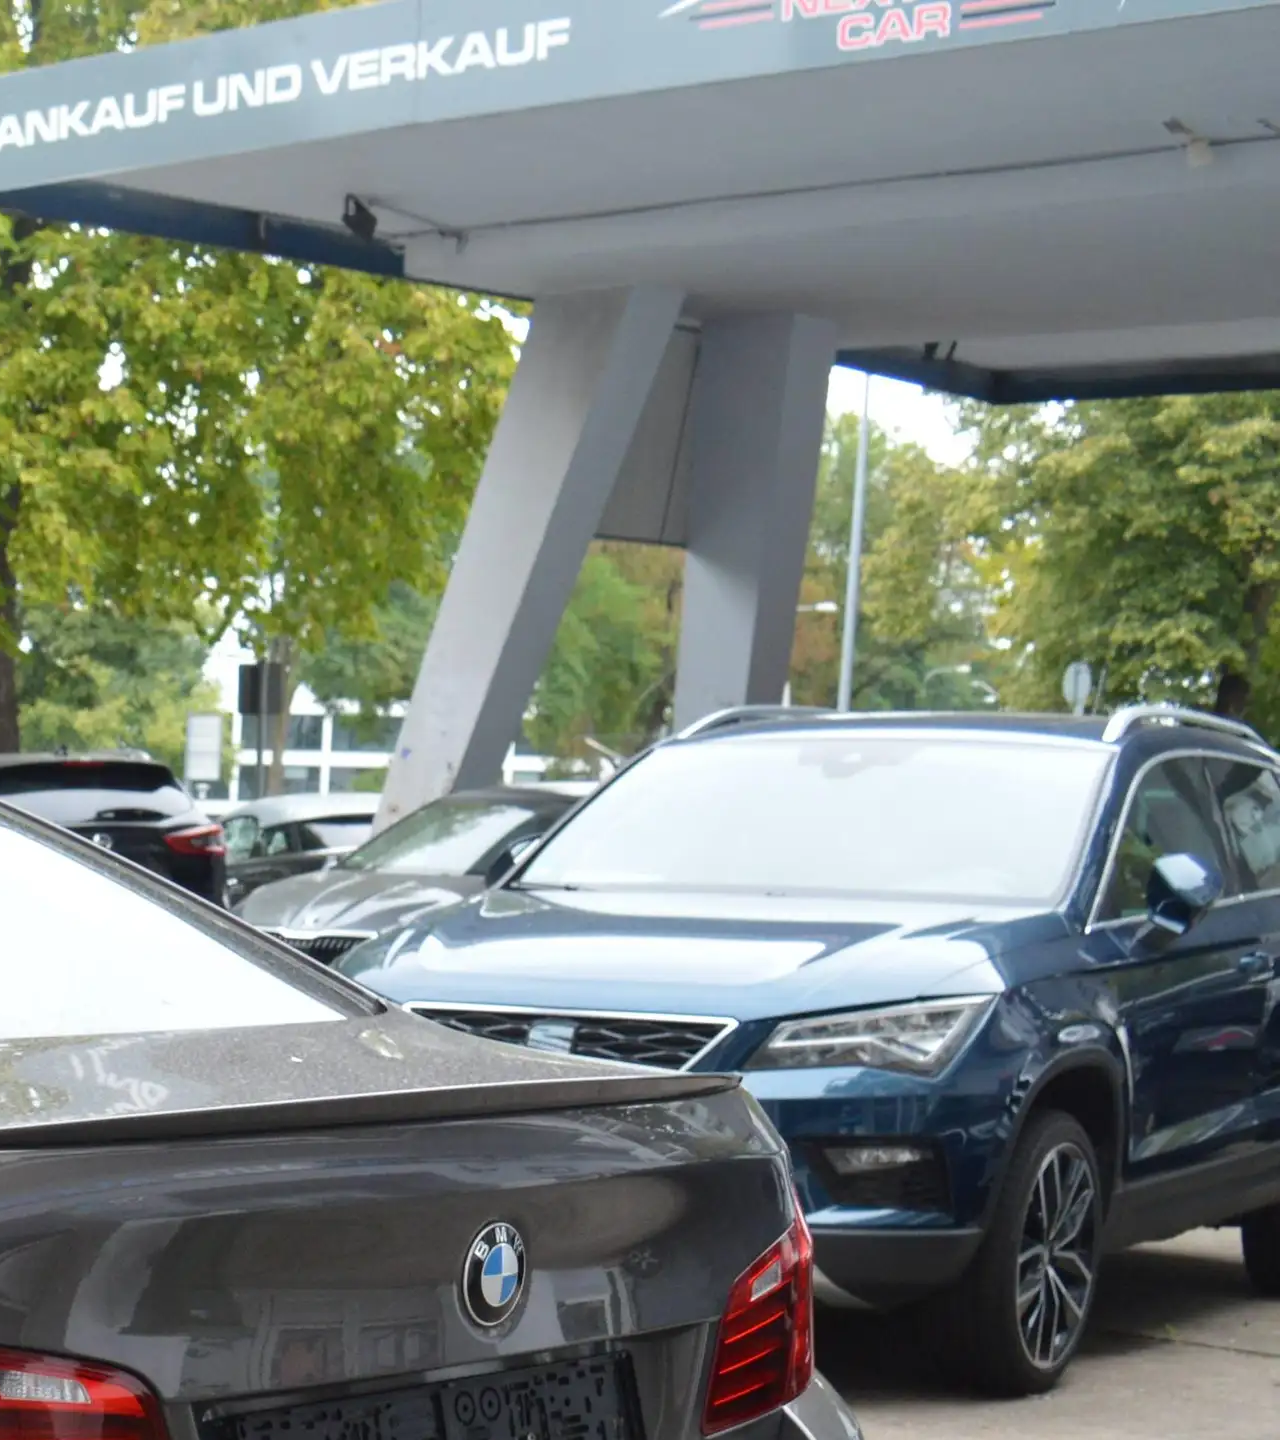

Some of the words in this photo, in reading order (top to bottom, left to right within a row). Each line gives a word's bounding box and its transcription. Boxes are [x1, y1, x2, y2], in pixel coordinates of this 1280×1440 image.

[837, 3, 951, 50] CAR
[193, 64, 302, 117] UND
[310, 17, 571, 95] VERKAUF
[473, 1226, 525, 1261] BMW
